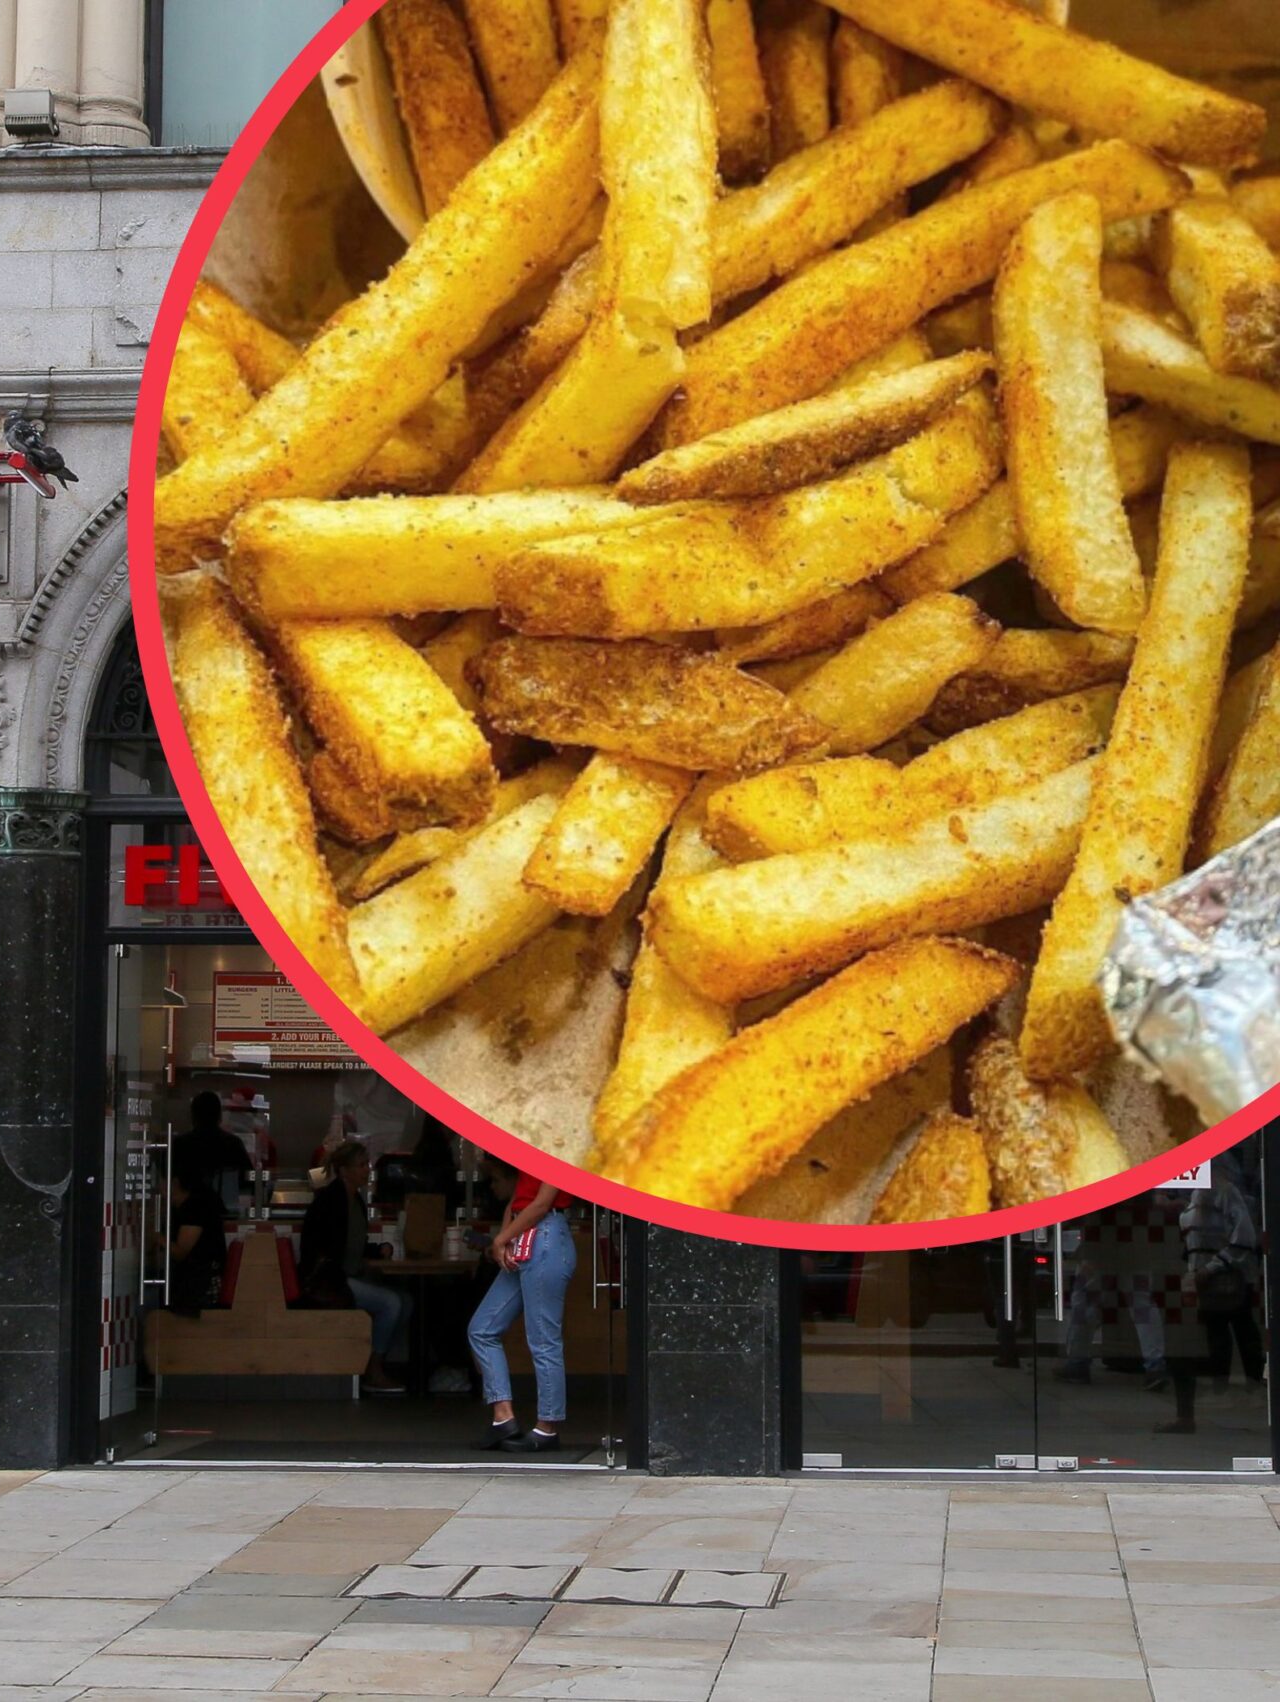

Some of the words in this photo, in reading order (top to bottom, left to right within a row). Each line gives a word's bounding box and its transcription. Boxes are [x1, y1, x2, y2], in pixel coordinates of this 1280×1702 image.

[281, 1033, 298, 1042] ADD
[299, 1033, 320, 1042] YOUR
[299, 1061, 322, 1070] PLEASE
[323, 1062, 344, 1070] SPEAK
